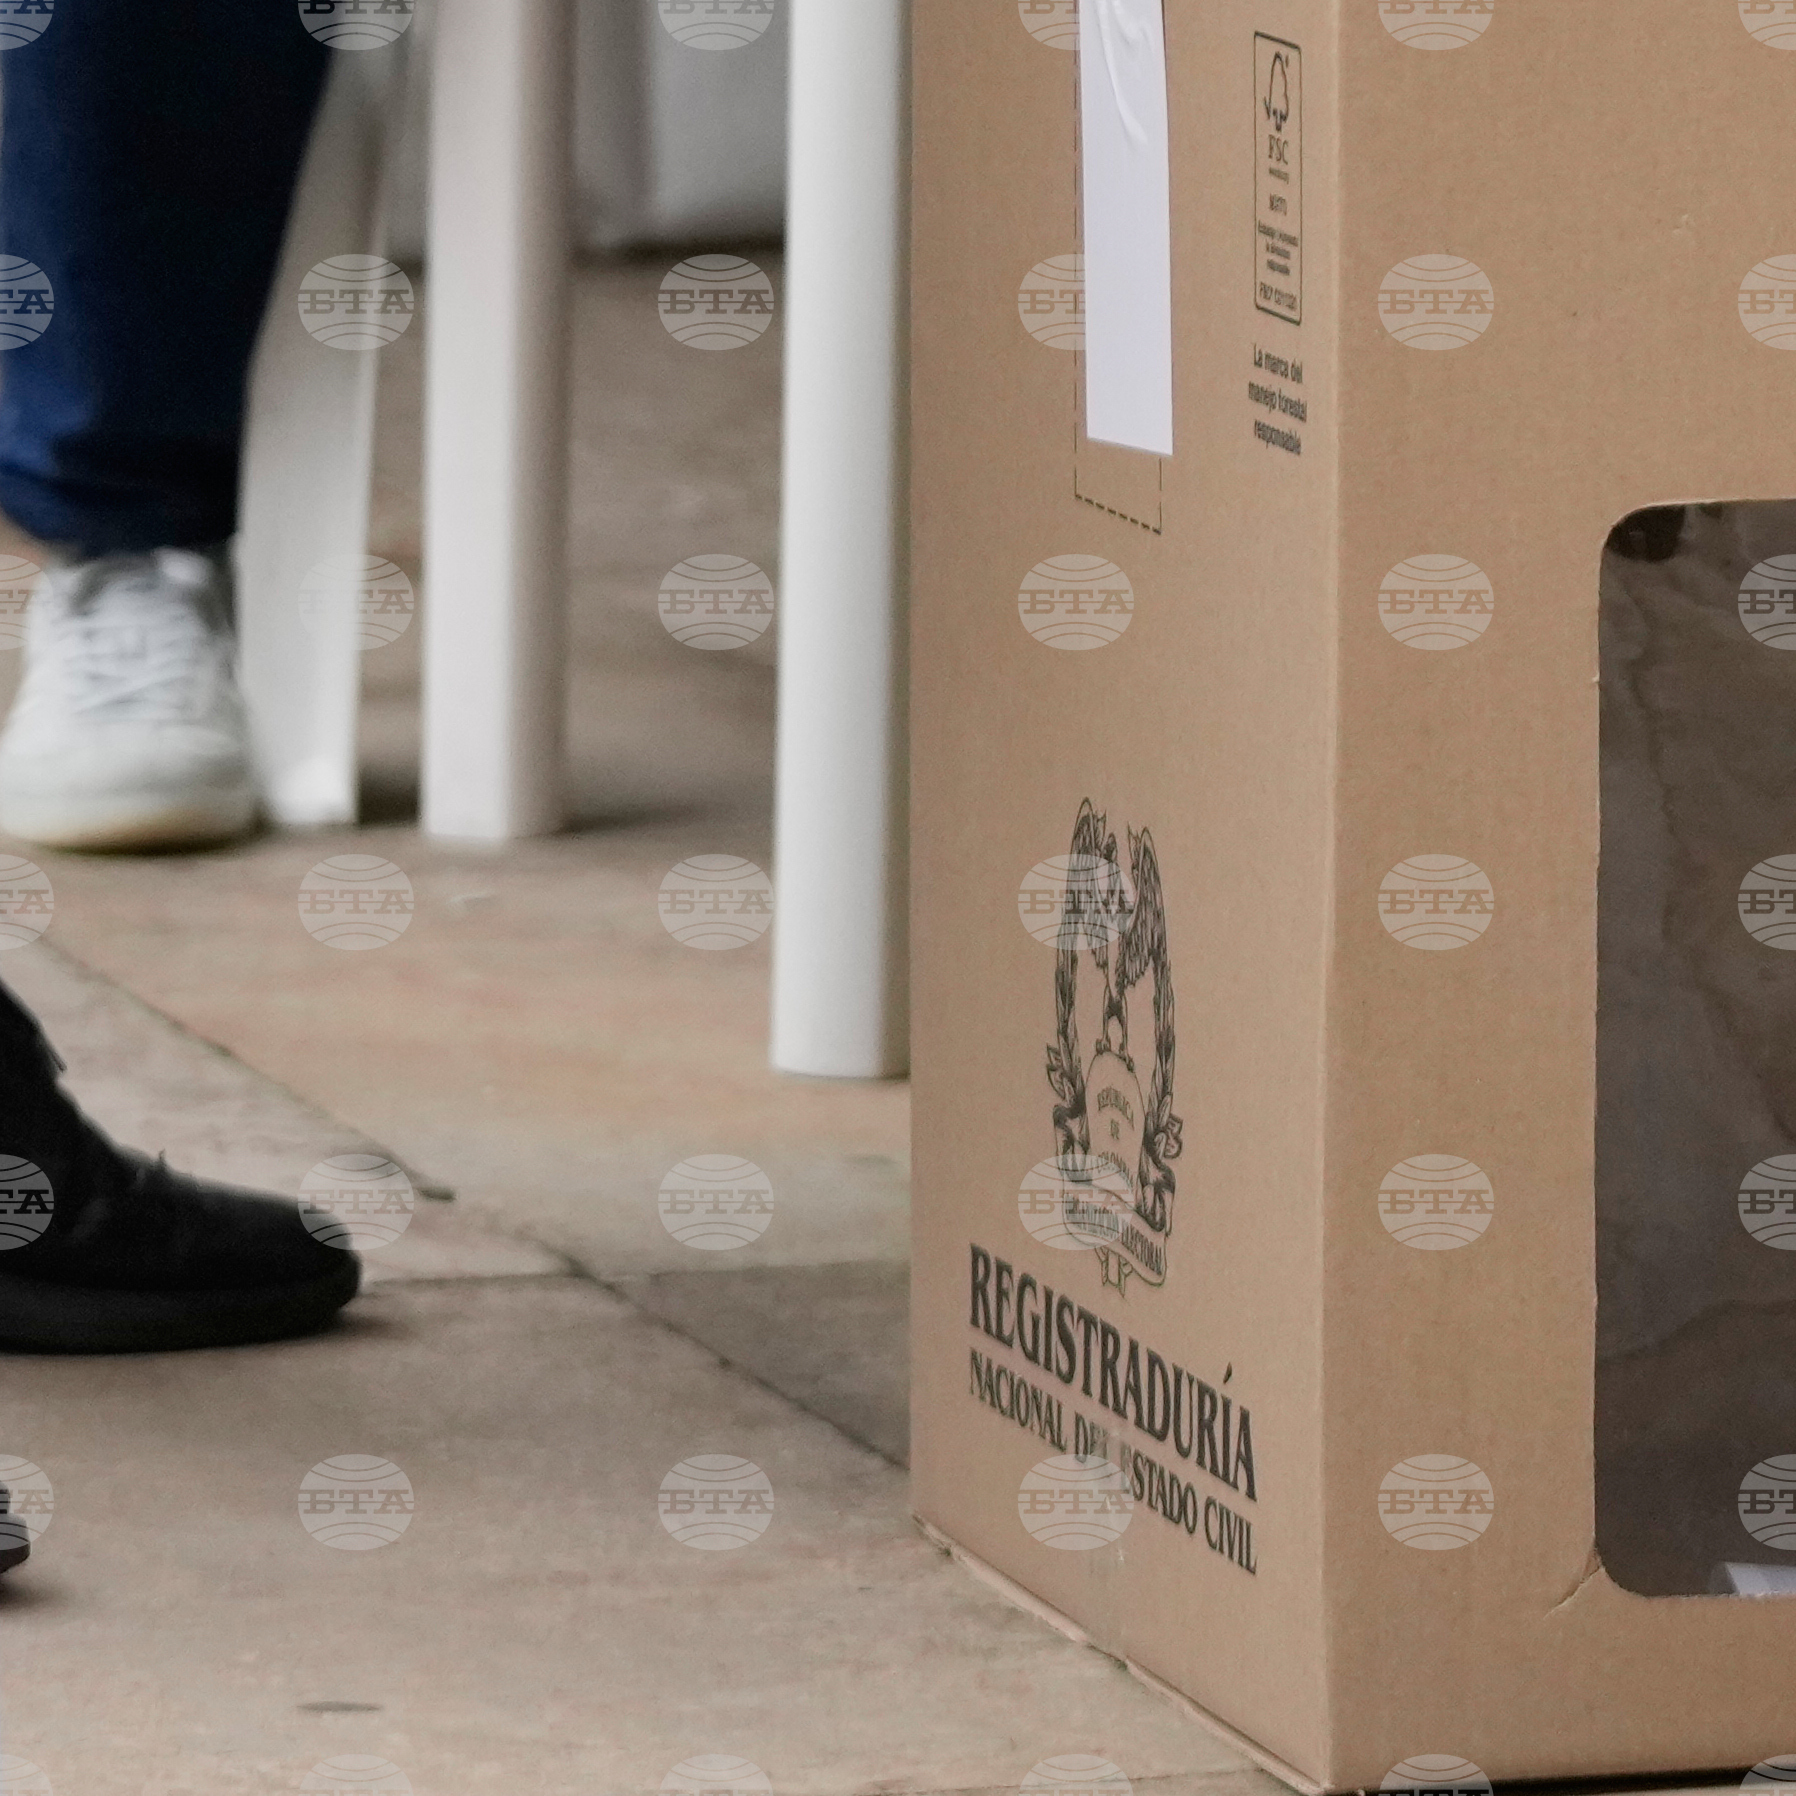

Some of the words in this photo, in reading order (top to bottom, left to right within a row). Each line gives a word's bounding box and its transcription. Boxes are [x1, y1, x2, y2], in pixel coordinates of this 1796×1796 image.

[1268, 133, 1289, 165] FSC
[970, 1242, 1258, 1503] REGISTRADURÍA
[970, 1346, 1068, 1453] NACIONAL
[1204, 1496, 1258, 1576] CIVIL
